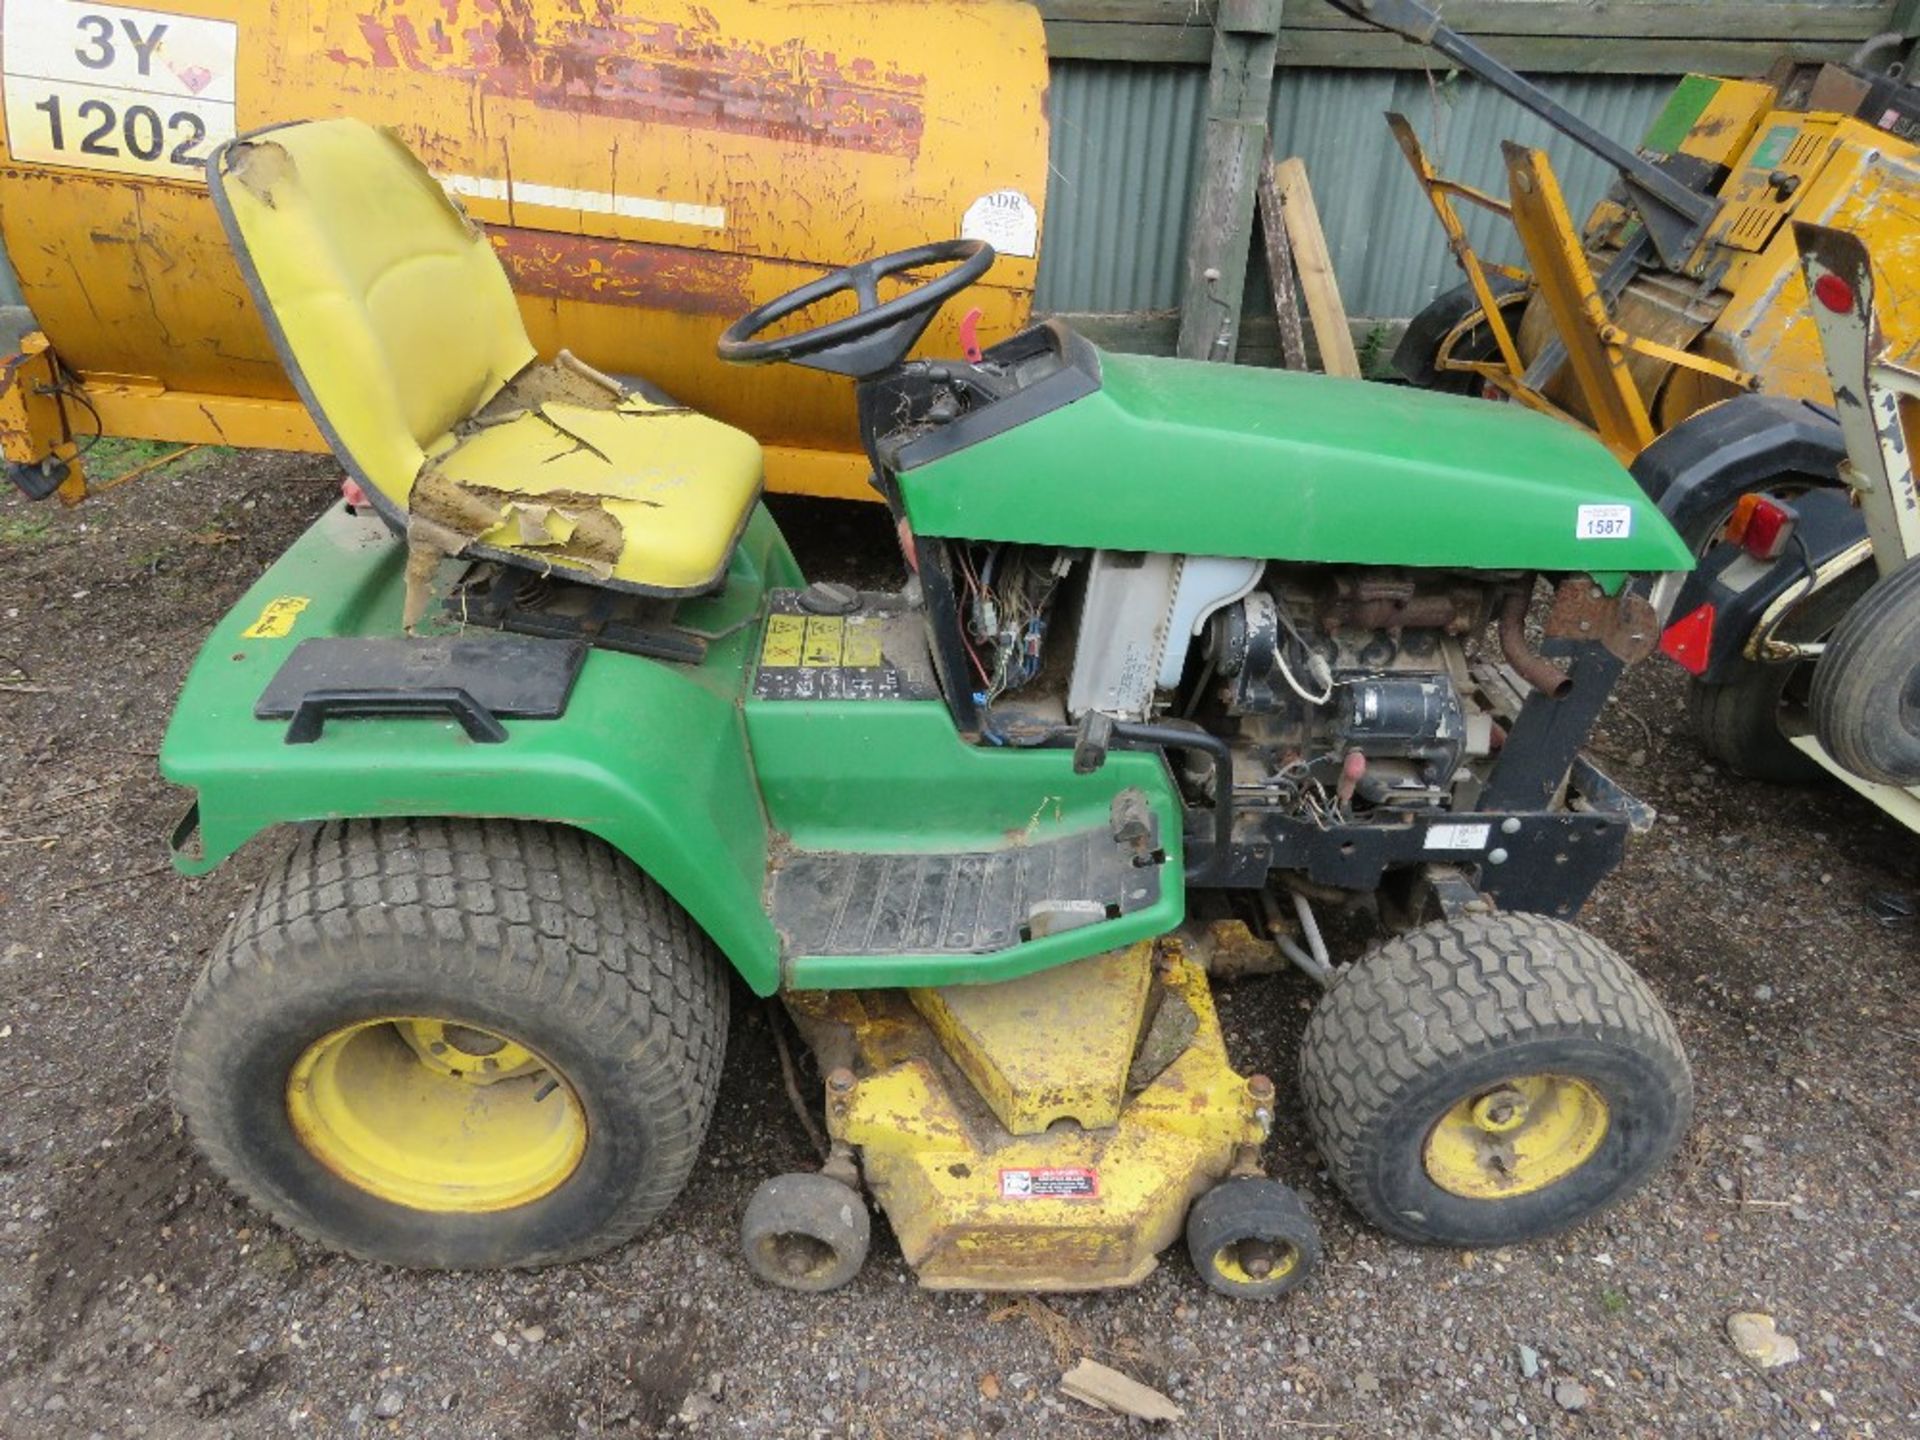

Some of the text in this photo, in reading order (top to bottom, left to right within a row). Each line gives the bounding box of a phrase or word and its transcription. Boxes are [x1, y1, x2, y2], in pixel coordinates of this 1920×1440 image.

[75, 15, 168, 76] 3Y
[35, 94, 206, 167] 1202
[1587, 519, 1624, 535] 1587
